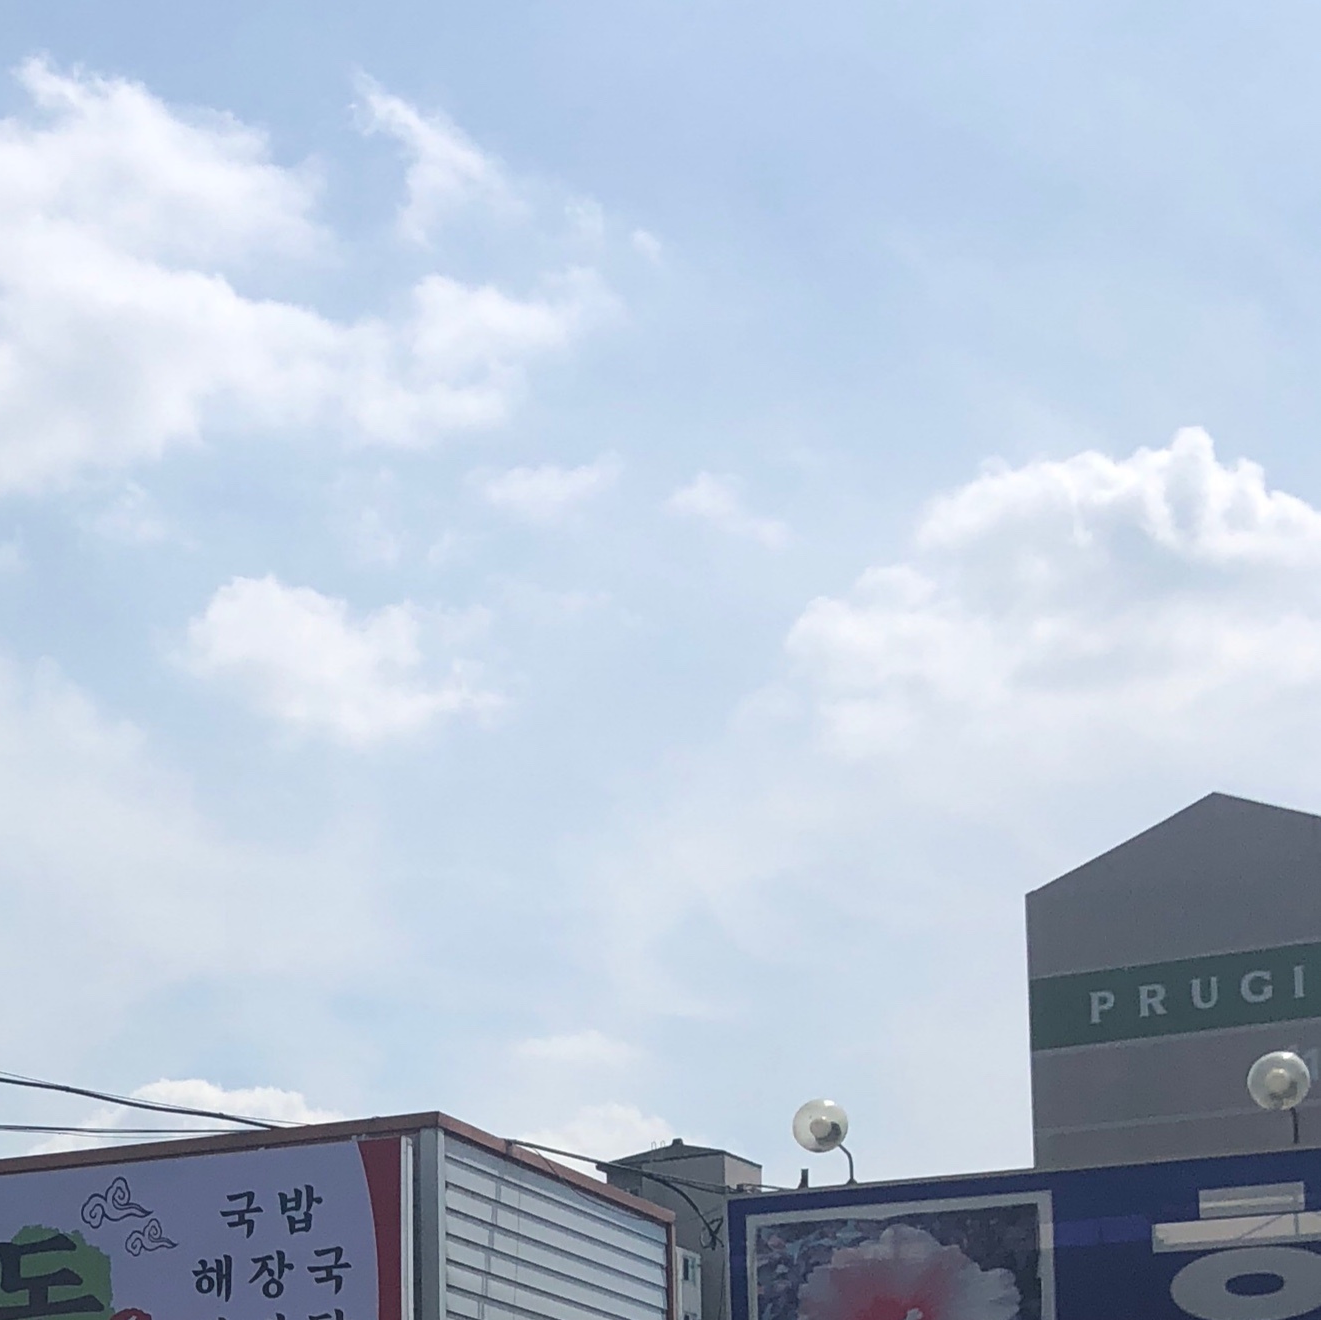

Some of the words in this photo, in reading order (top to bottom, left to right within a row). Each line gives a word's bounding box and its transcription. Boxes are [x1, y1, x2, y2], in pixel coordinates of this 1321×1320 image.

[1089, 964, 1307, 1025] PRUGI
[219, 1184, 323, 1238] 국밥
[190, 1246, 353, 1300] 해장국
